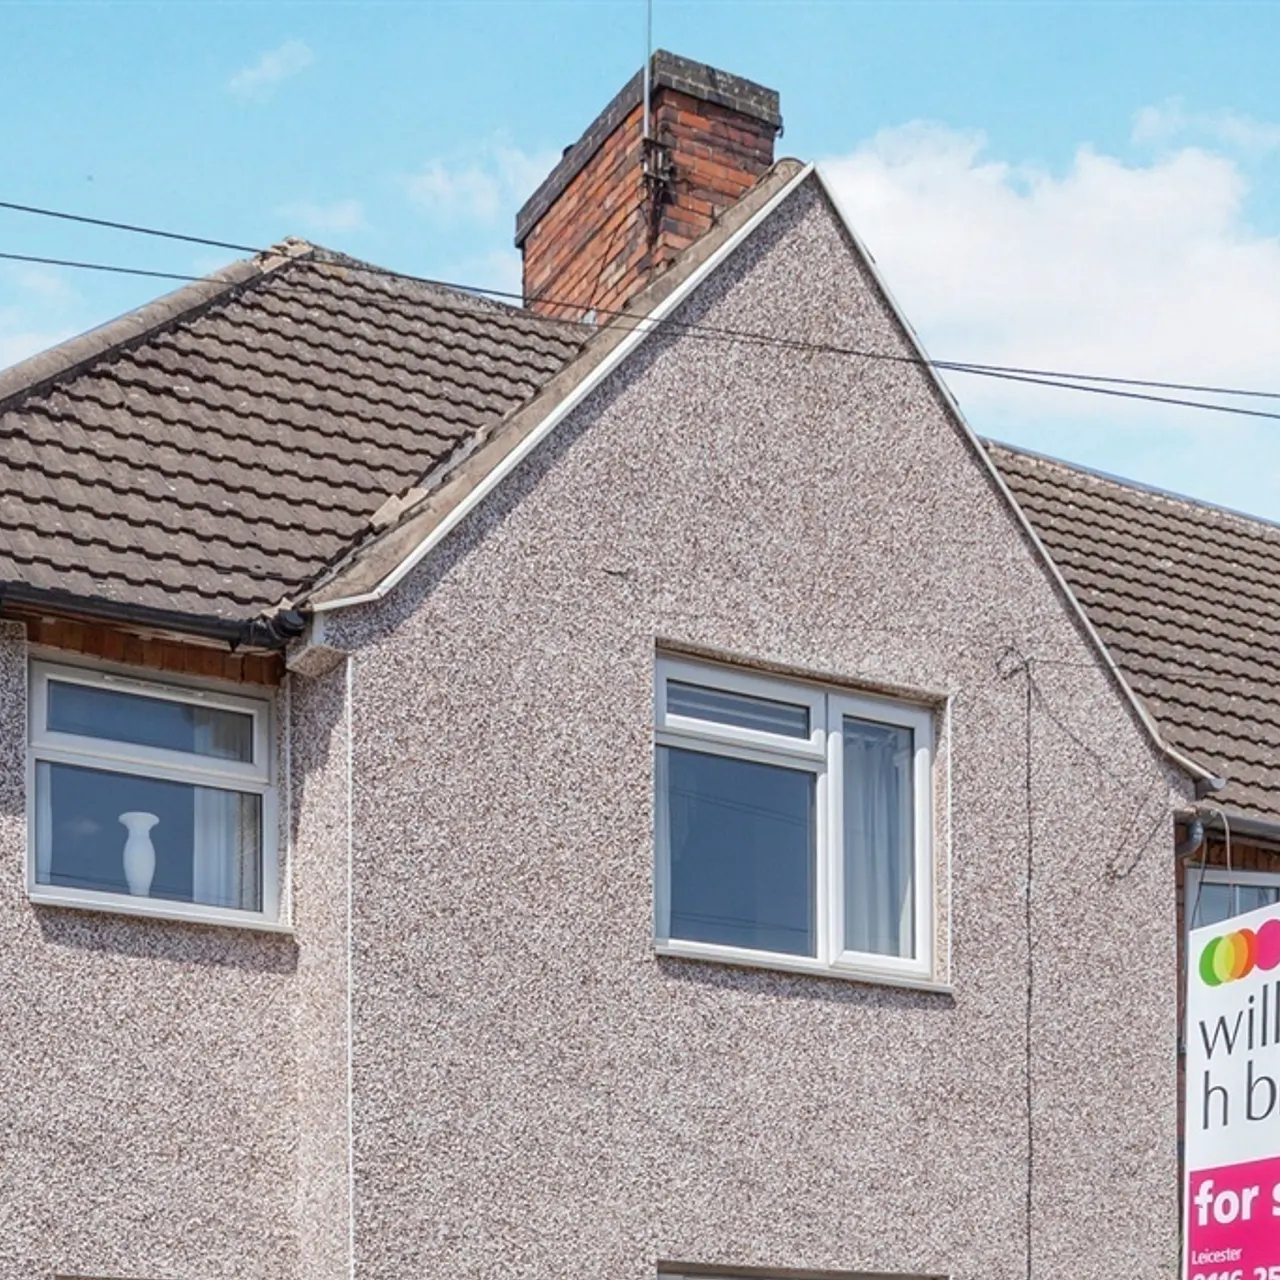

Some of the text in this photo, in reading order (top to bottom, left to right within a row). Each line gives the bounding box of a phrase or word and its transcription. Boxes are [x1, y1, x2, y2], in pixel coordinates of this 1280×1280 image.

[1202, 1069, 1229, 1130] h
[1194, 1179, 1260, 1227] for
[1191, 1247, 1243, 1266] Leicester
